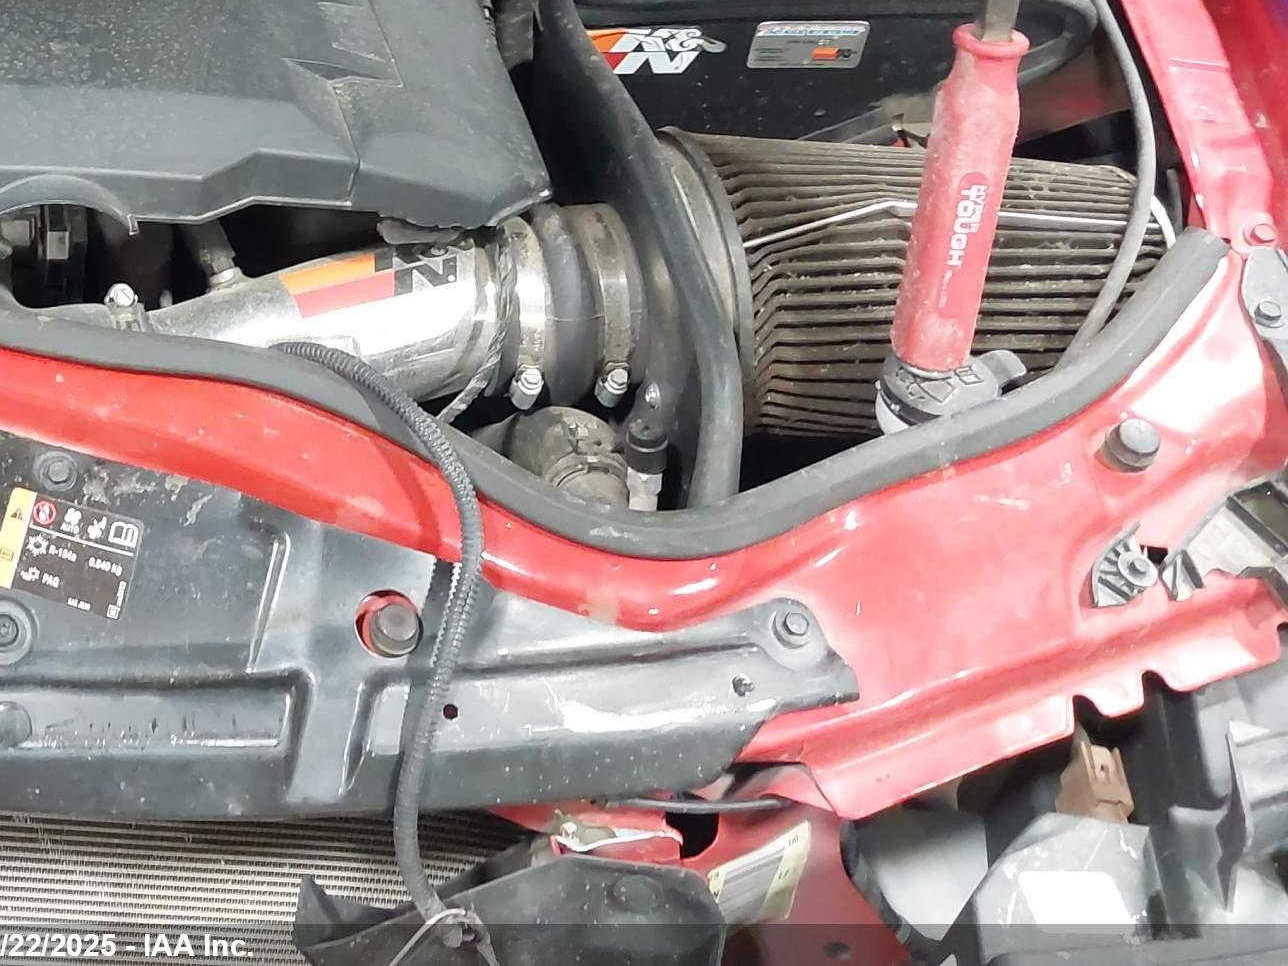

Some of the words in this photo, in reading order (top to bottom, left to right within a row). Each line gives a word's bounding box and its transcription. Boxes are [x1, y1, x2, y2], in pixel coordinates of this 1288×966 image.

[610, 27, 726, 75] K&N
[946, 189, 976, 267] TOUGH
[969, 185, 988, 234] HYPER
